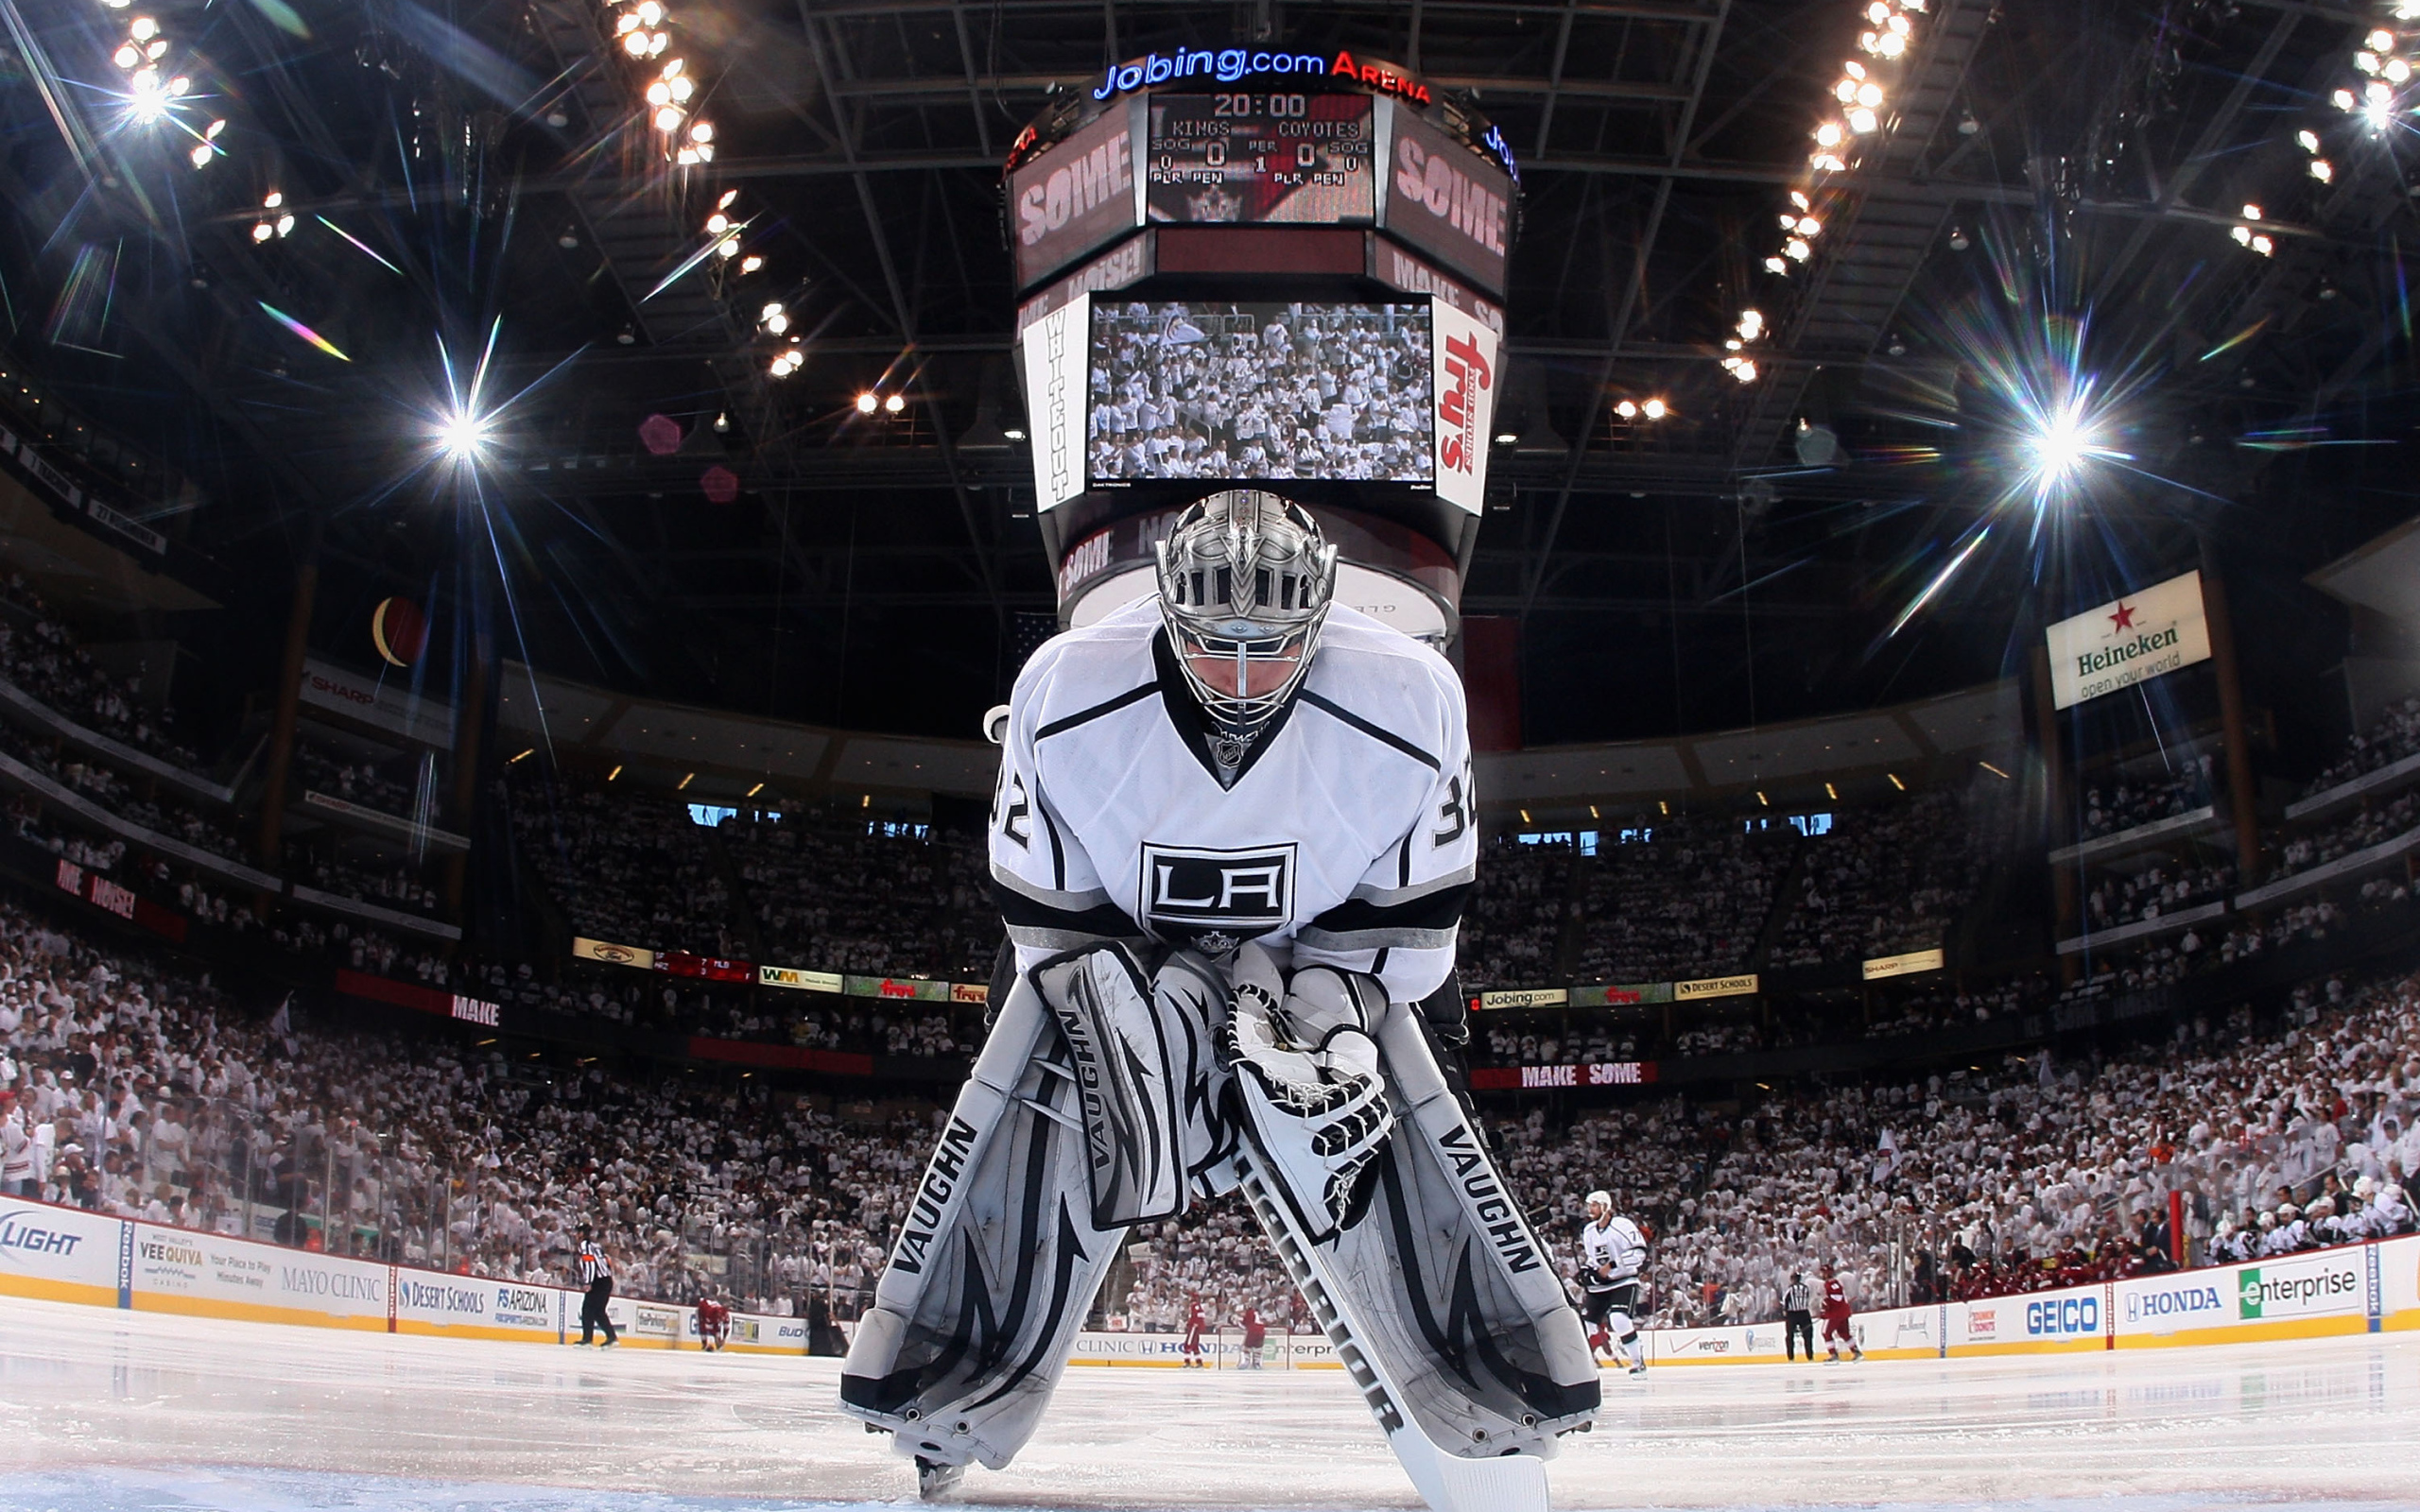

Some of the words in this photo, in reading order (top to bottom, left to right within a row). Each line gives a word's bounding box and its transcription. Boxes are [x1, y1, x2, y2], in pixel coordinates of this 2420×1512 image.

[1094, 47, 1324, 100] Jobing.com
[1215, 94, 1305, 117] 20:00
[1172, 121, 1230, 137] KINGS
[1279, 122, 1359, 138] COYOTES
[1151, 139, 1191, 151] SOG
[1206, 143, 1225, 166] 0
[1249, 141, 1277, 152] PER
[1297, 143, 1316, 167] 0
[1329, 141, 1368, 154] SOG
[1152, 172, 1183, 184] PLR
[1192, 172, 1223, 184] PEN
[1254, 156, 1267, 173] 1
[1273, 173, 1305, 185] PLR
[1313, 173, 1344, 185] PEN
[1020, 130, 1132, 246] SOME
[1397, 138, 1507, 258] SOME
[1466, 366, 1477, 407] FOOD
[1046, 308, 1069, 502] WHITEOUT
[1465, 409, 1475, 467] STORES
[2077, 627, 2179, 678] Heineken
[2082, 678, 2113, 698] open
[2116, 666, 2143, 688] your
[2146, 651, 2181, 679] world
[311, 675, 374, 705] SHARP
[1152, 864, 1284, 910] LA
[762, 968, 799, 984] WM
[1691, 981, 1719, 992] DESERT
[1720, 977, 1753, 989] SCHOOLS
[452, 994, 500, 1027] MAKE
[1487, 991, 1555, 1006] Jobing.com
[1522, 1065, 1577, 1088] MAKE
[1589, 1062, 1642, 1085] SOME
[1058, 1009, 1113, 1171] VAUGHN
[891, 1115, 978, 1276] VAUGHN
[1437, 1124, 1544, 1274] VAUGHN
[1, 1222, 82, 1256] LIGHT
[121, 1221, 133, 1290] Reebok
[210, 1254, 226, 1265] Your
[228, 1257, 247, 1269] Place
[248, 1260, 256, 1270] to
[256, 1261, 271, 1275] Play
[282, 1267, 329, 1295] MAYO
[331, 1273, 381, 1302] CLINIC
[412, 1280, 445, 1310] DESERT
[447, 1286, 484, 1314] SCHOOLS
[2242, 1267, 2357, 1306] enterprise
[2027, 1297, 2099, 1335] GEICO
[2142, 1287, 2222, 1316] HONDA
[778, 1325, 804, 1338] BUD
[1077, 1339, 1134, 1353] CLINIC
[1698, 1337, 1729, 1352] verizon
